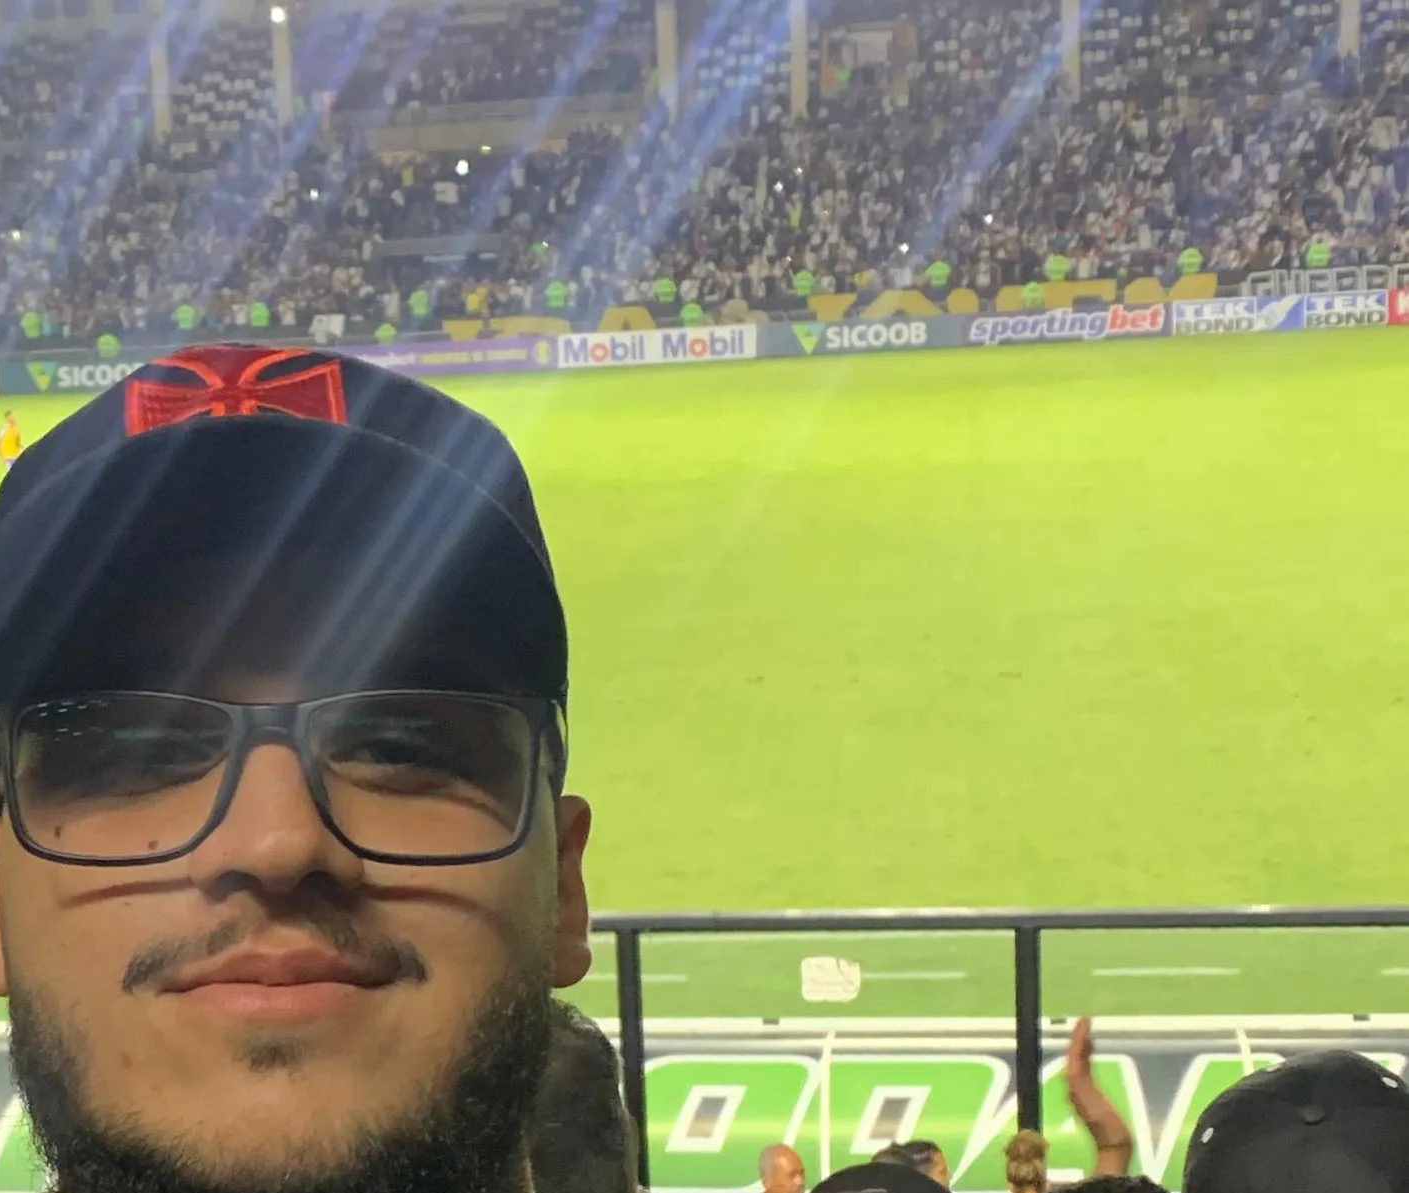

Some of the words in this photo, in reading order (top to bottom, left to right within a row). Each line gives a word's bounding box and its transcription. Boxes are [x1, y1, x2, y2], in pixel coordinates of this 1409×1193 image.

[1181, 300, 1252, 318] TEK
[1307, 291, 1385, 311] TEK
[969, 303, 1165, 346] sportingbet
[1306, 309, 1385, 327] BOND
[563, 335, 645, 364] Mobil
[662, 330, 745, 360] Mobil
[826, 322, 927, 349] SICOOB
